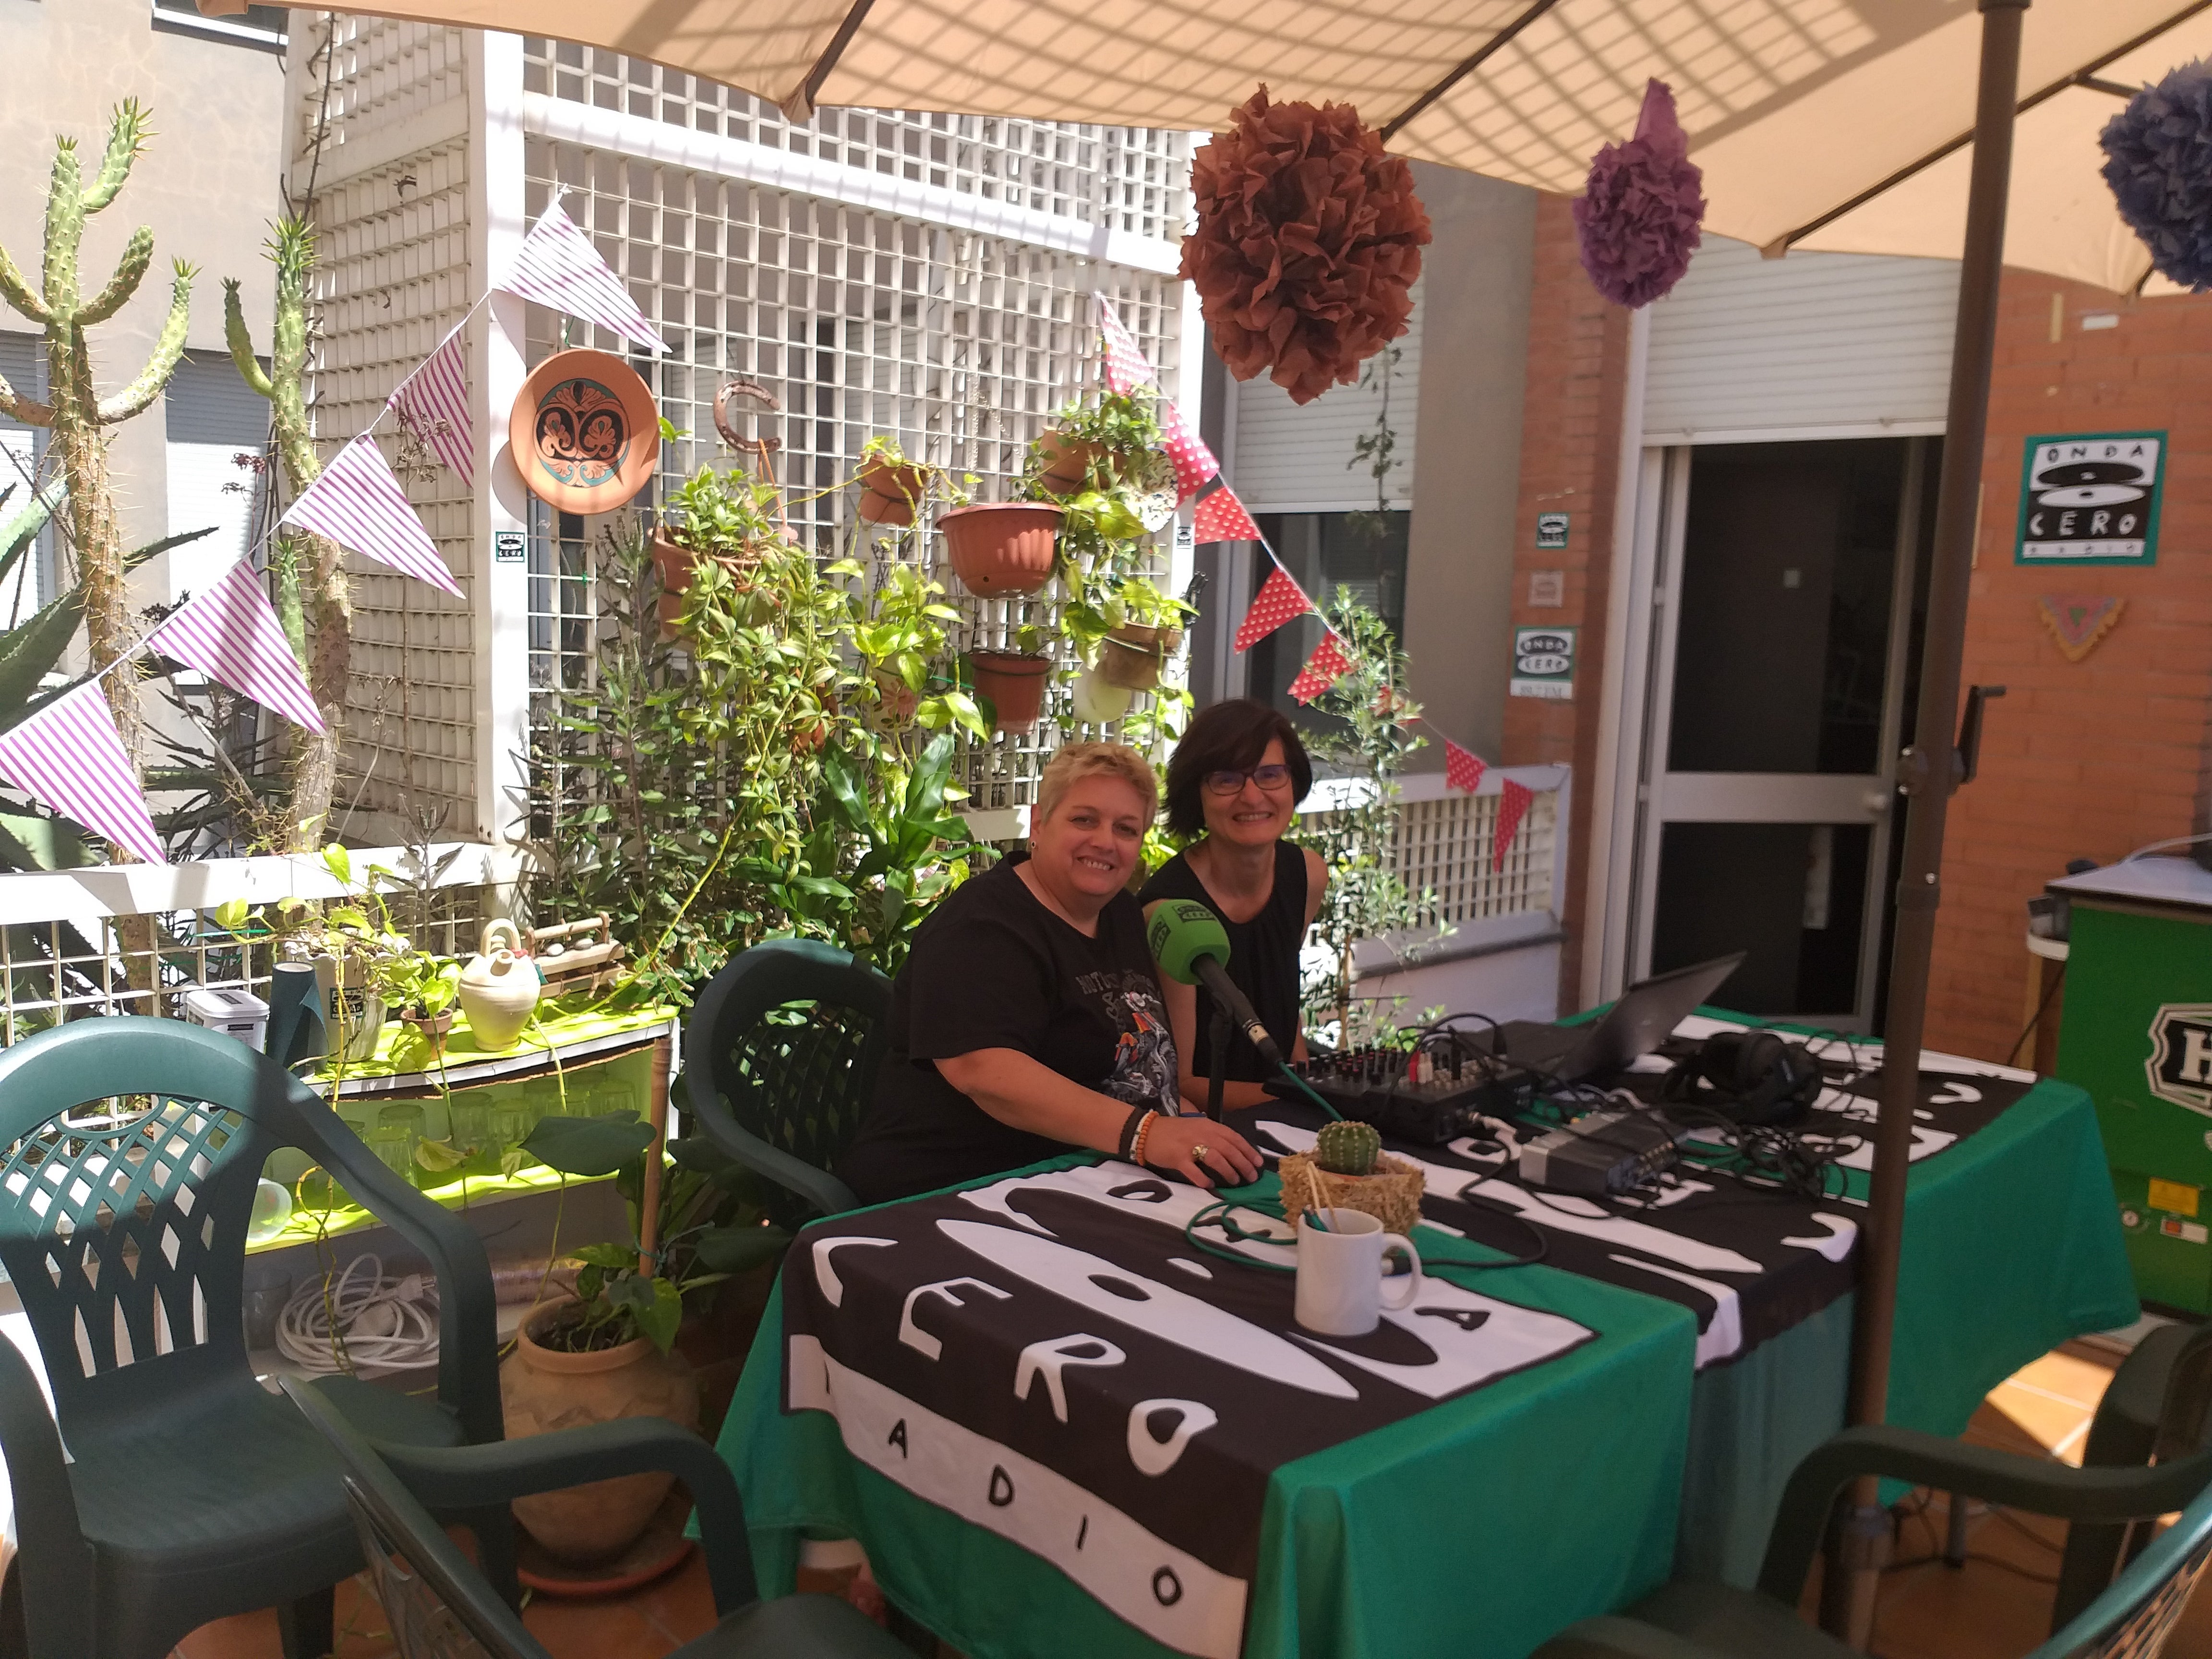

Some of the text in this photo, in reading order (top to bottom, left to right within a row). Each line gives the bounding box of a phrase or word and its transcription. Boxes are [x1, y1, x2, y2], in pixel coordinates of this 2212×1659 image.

[2047, 445, 2143, 462] ONDA
[2029, 510, 2138, 537] CERO
[811, 1236, 1218, 1477] CERO
[824, 1359, 1183, 1607] ADIO
